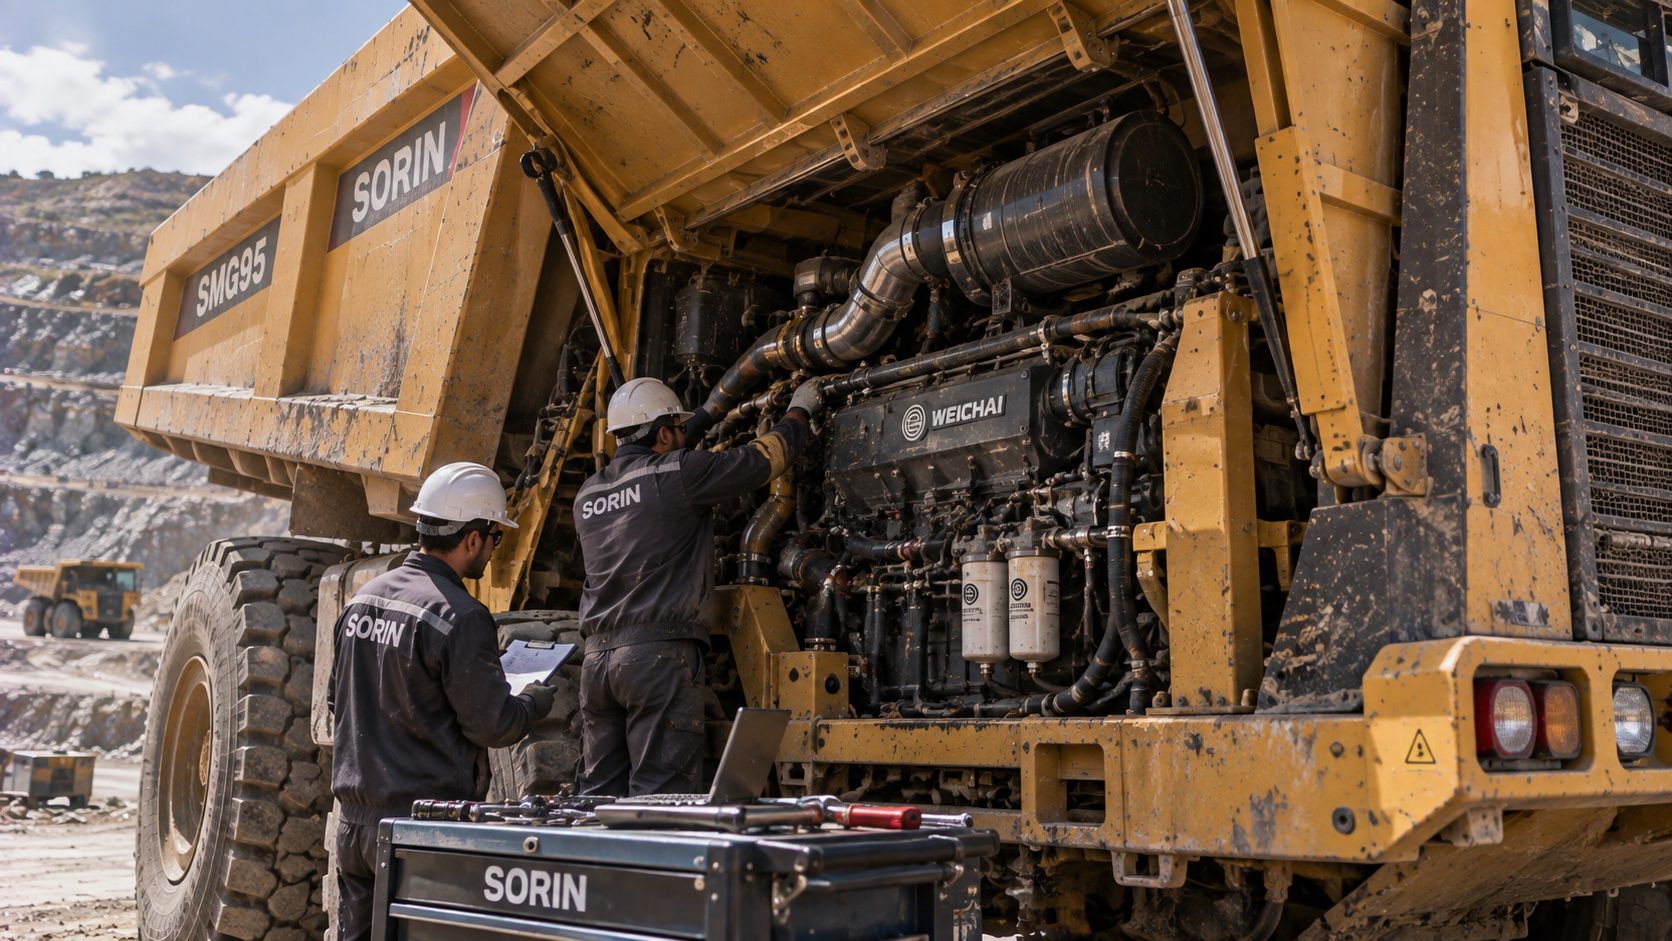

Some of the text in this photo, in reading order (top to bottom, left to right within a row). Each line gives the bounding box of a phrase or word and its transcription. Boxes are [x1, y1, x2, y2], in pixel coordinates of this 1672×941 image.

[352, 121, 446, 223] SORIN
[196, 236, 267, 317] SMG95
[932, 395, 1003, 427] WEICHAI
[582, 483, 641, 519] SORIN
[345, 613, 405, 648] SORIN
[483, 865, 588, 912] SORIN
